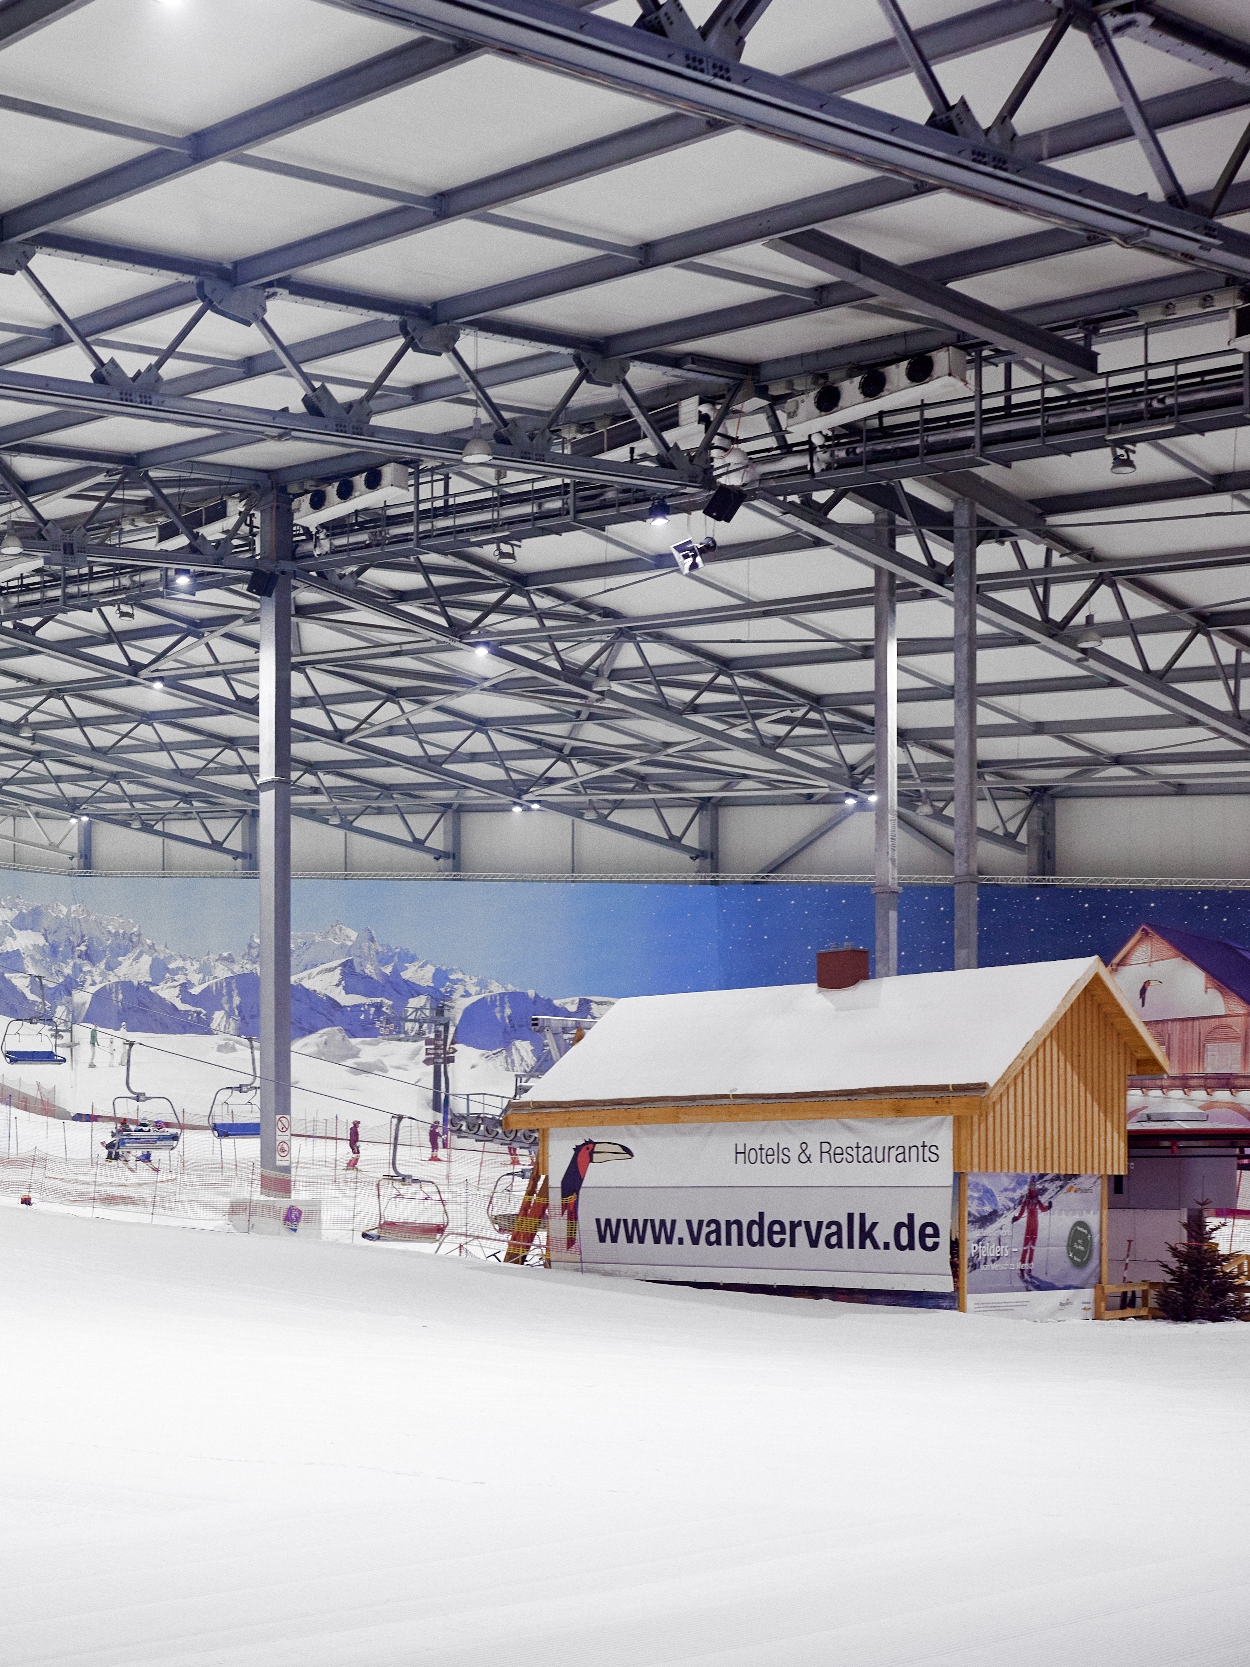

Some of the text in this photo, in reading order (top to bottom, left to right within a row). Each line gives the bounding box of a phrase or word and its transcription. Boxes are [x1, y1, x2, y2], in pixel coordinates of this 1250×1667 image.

[734, 1140, 940, 1164] Hotels & Restaurants
[595, 1211, 940, 1251] www.vandervalk.de
[971, 1242, 1009, 1259] Pfelders
